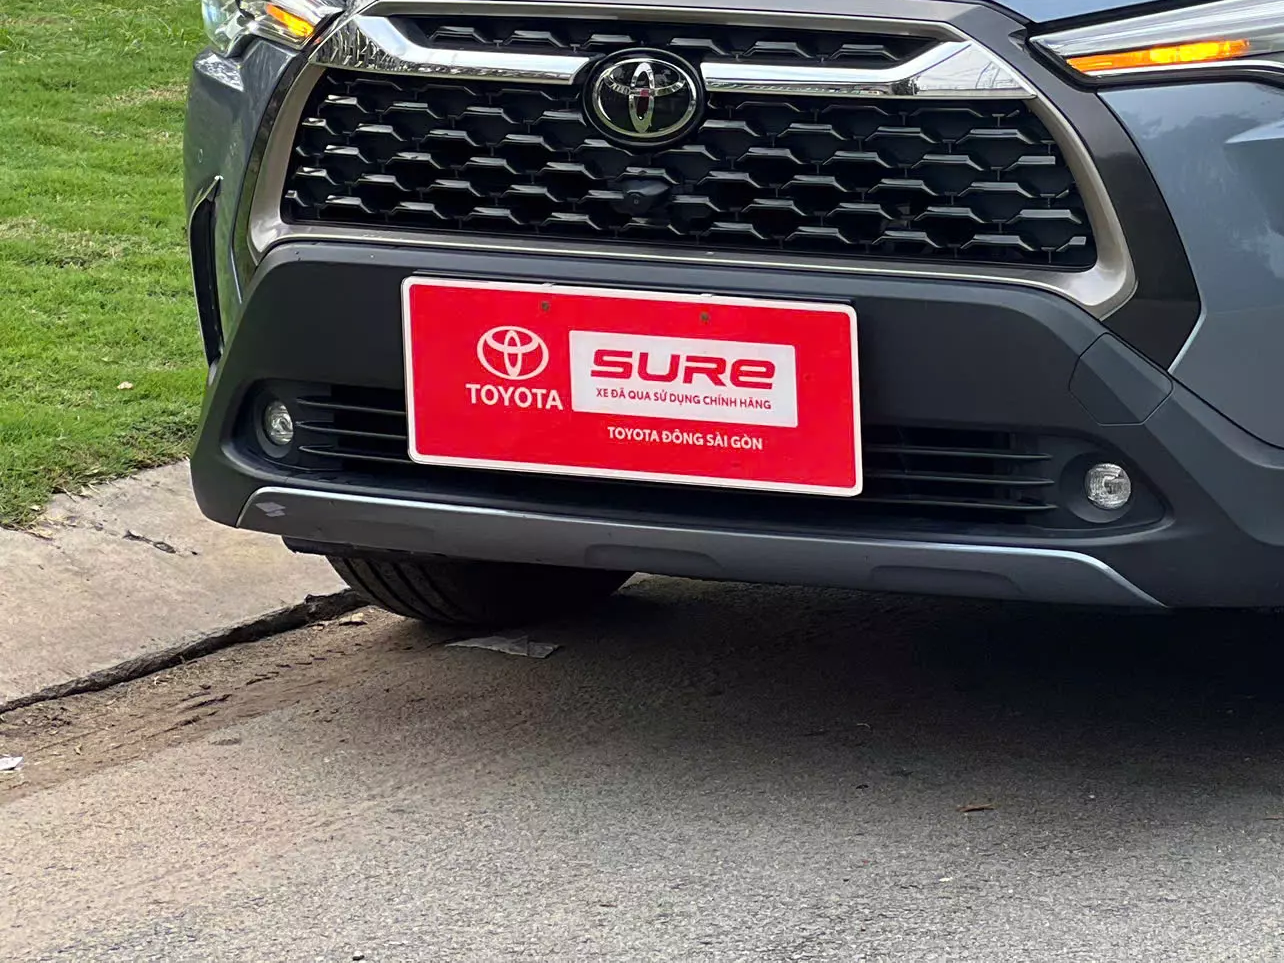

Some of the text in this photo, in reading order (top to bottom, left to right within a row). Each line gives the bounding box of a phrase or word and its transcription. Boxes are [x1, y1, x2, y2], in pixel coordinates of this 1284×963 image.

[465, 383, 564, 411] TOYOTA
[596, 387, 772, 410] XE ĐÃ QUA SỬ DỤNG CHÍNH HÃNG
[607, 426, 763, 450] TOYOTA ĐÔNG SÀI GÒN
